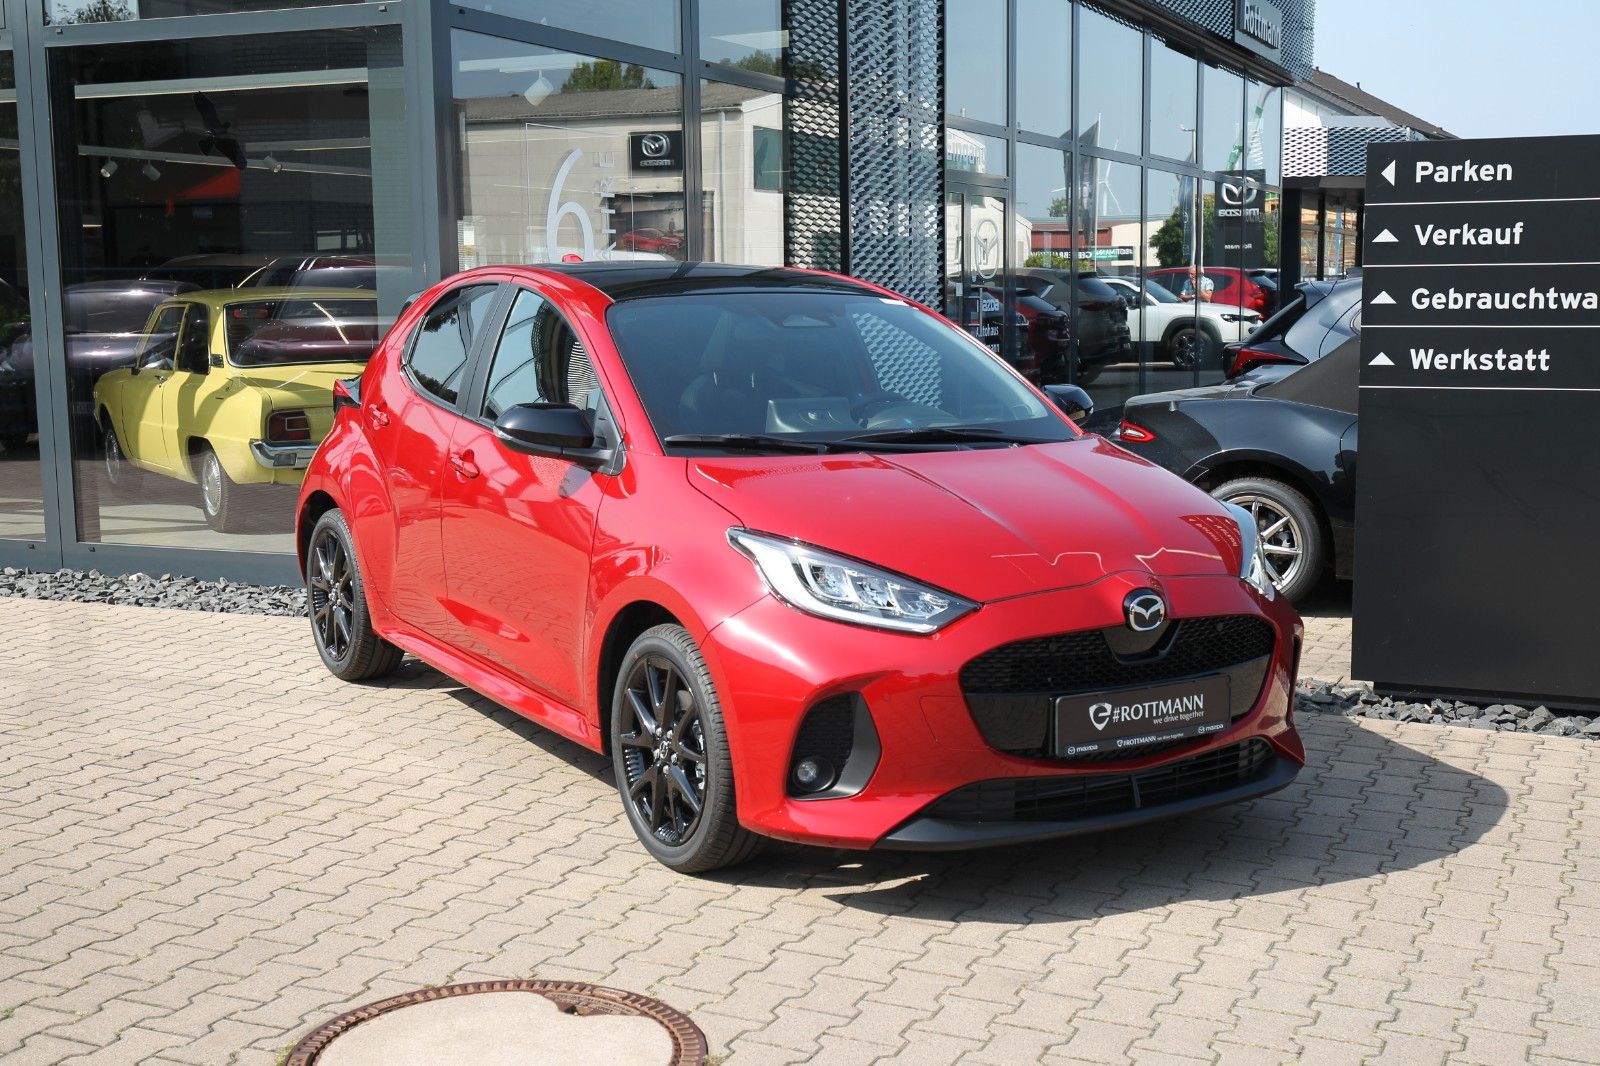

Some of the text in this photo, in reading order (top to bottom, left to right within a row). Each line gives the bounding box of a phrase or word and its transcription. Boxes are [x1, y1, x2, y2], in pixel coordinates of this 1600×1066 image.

[1244, 0, 1281, 49] Rottmann
[1415, 159, 1513, 183] Parken
[1414, 221, 1524, 246] Verkauf
[1411, 287, 1598, 310] Gebrauchtwa
[1410, 348, 1550, 371] Werkstatt
[1112, 693, 1204, 723] #ROTTMANN
[1153, 710, 1205, 725] we drive together
